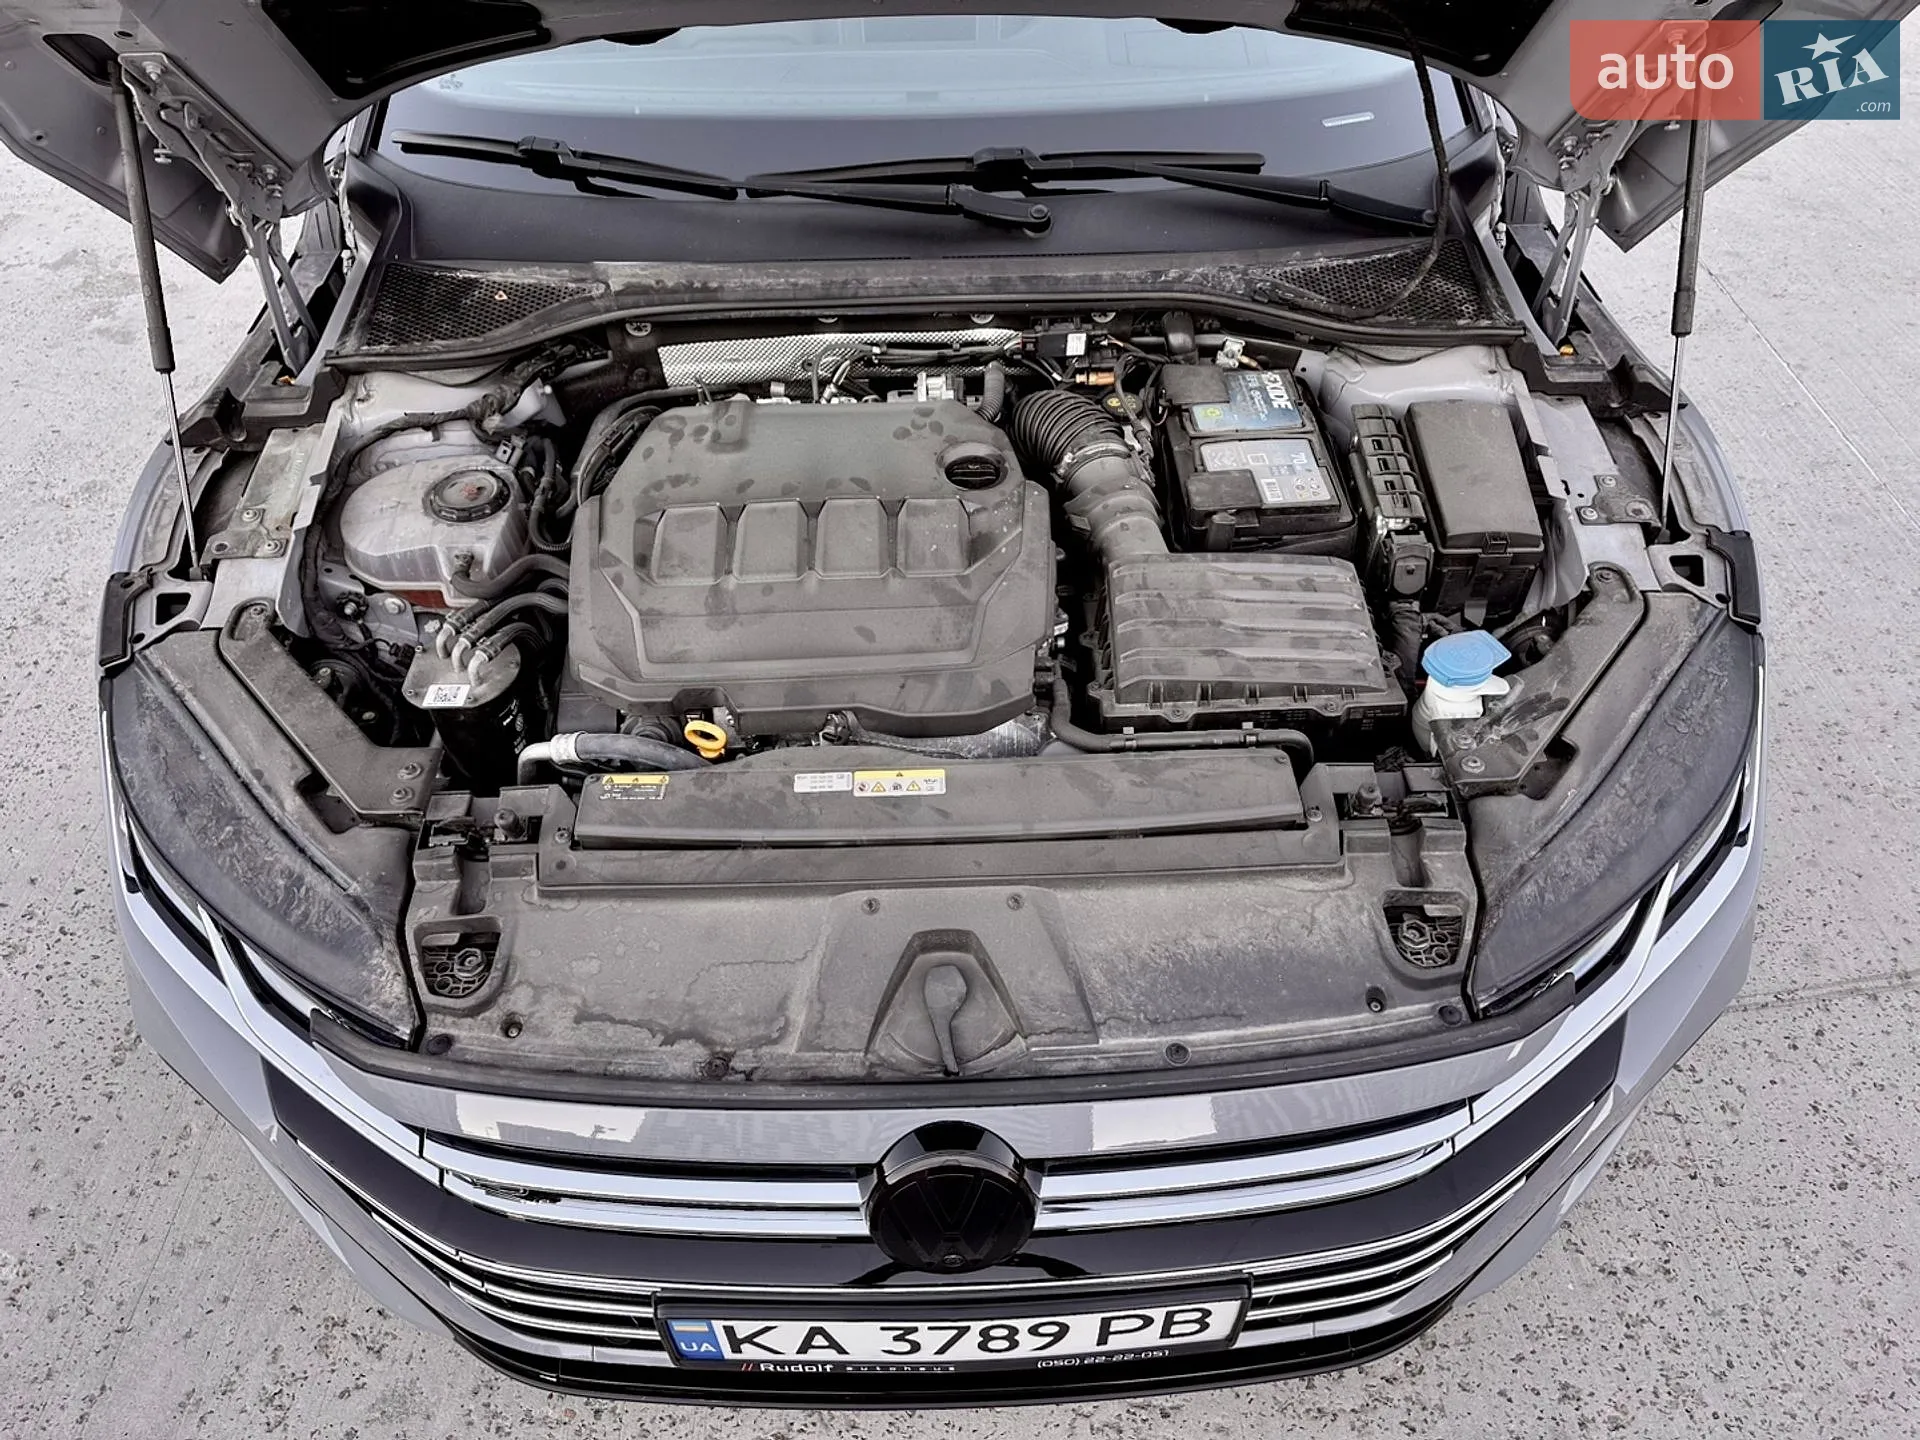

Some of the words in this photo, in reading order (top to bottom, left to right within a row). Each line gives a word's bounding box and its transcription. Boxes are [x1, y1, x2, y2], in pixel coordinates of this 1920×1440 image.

[1261, 371, 1293, 410] EXIDE
[722, 1325, 850, 1355] KA
[880, 1320, 1070, 1355] 3789
[1096, 1307, 1213, 1347] PB
[680, 1341, 717, 1353] UA
[759, 1362, 834, 1373] Rudolf
[1036, 1356, 1081, 1369] (050)
